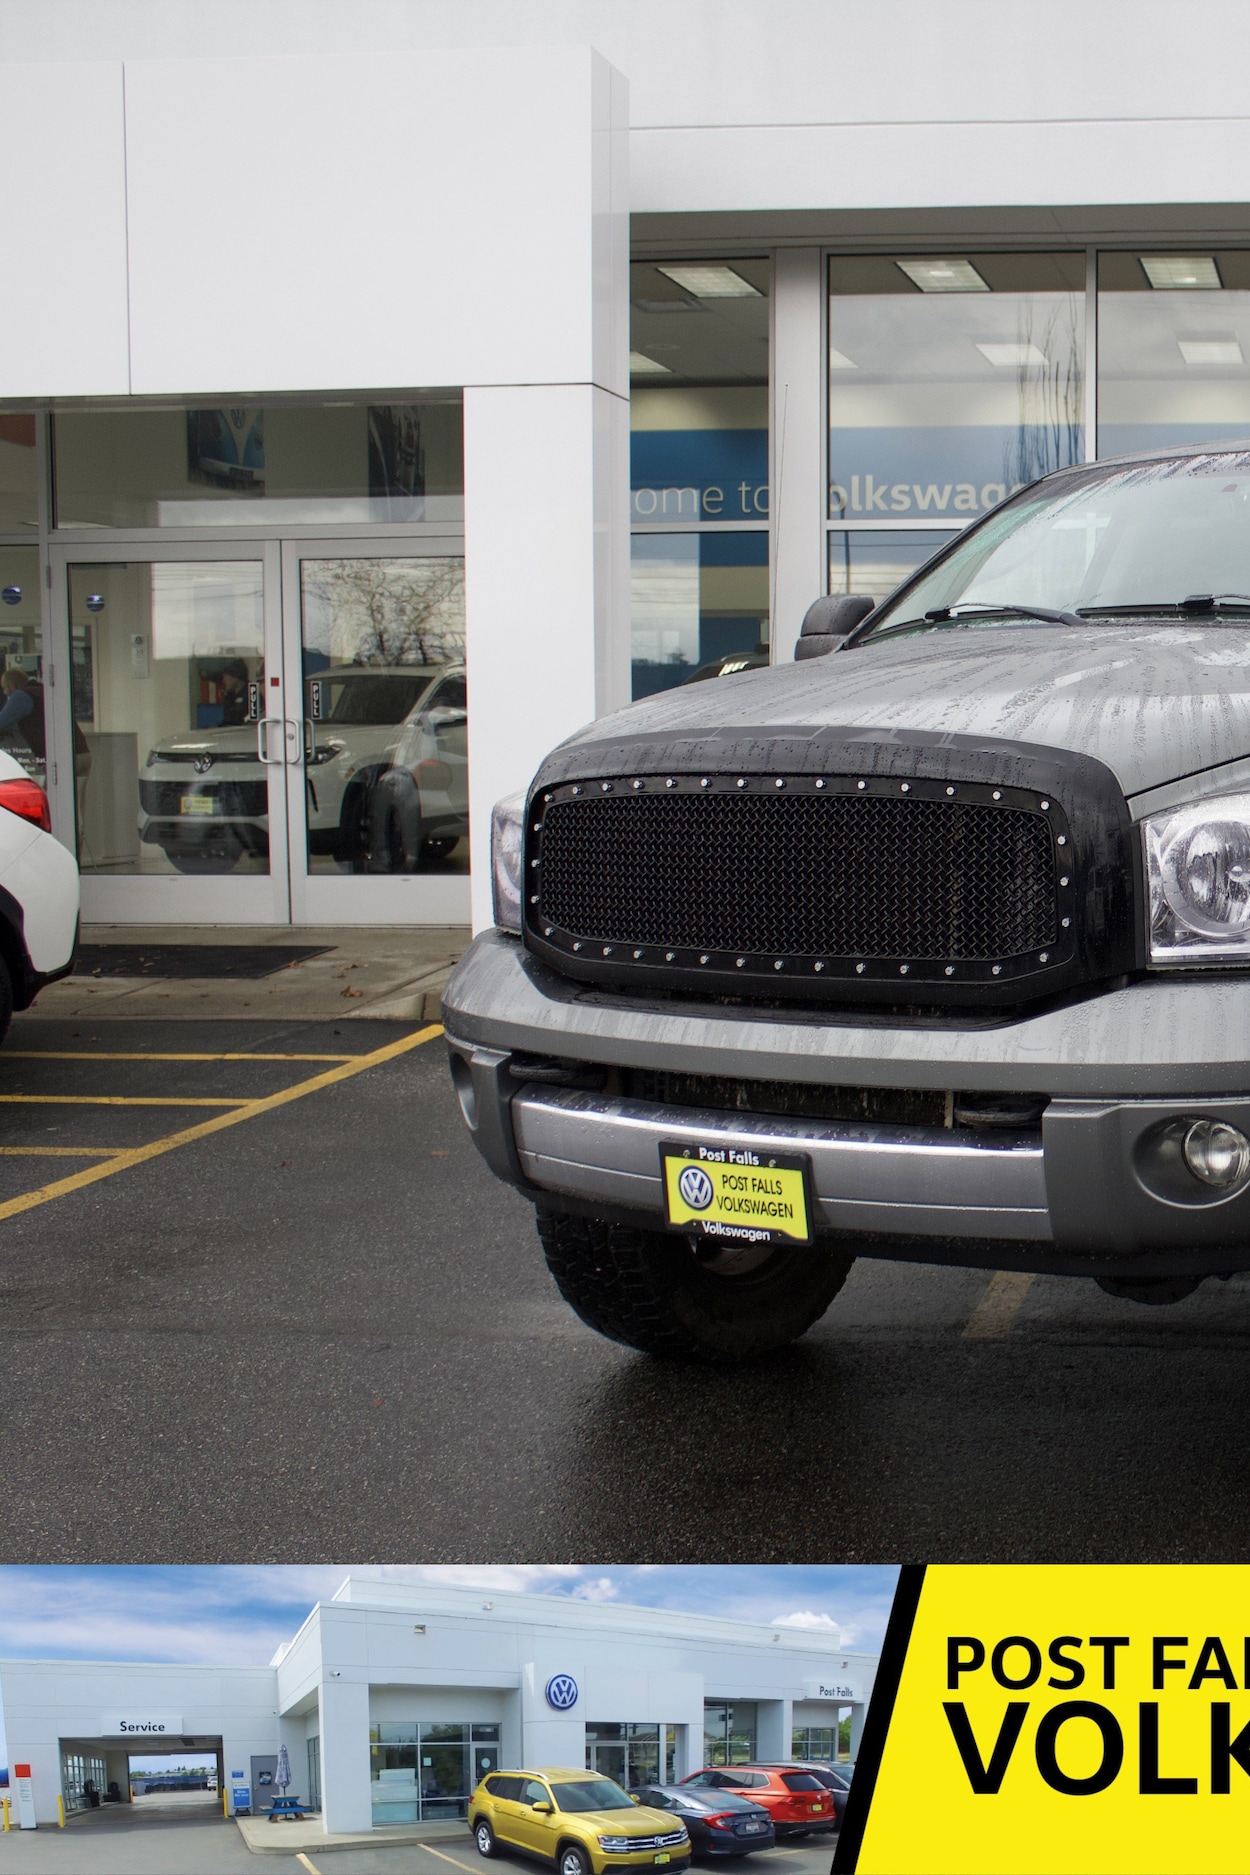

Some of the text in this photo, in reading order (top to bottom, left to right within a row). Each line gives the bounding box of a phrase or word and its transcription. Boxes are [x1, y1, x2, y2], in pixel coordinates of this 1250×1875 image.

[635, 486, 724, 515] ome
[829, 473, 1027, 512] olkswag
[699, 1147, 760, 1166] Post Falls
[722, 1174, 783, 1196] POST FALLS
[716, 1195, 794, 1219] VOLKSWAGEN
[702, 1220, 771, 1242] Volkswagen
